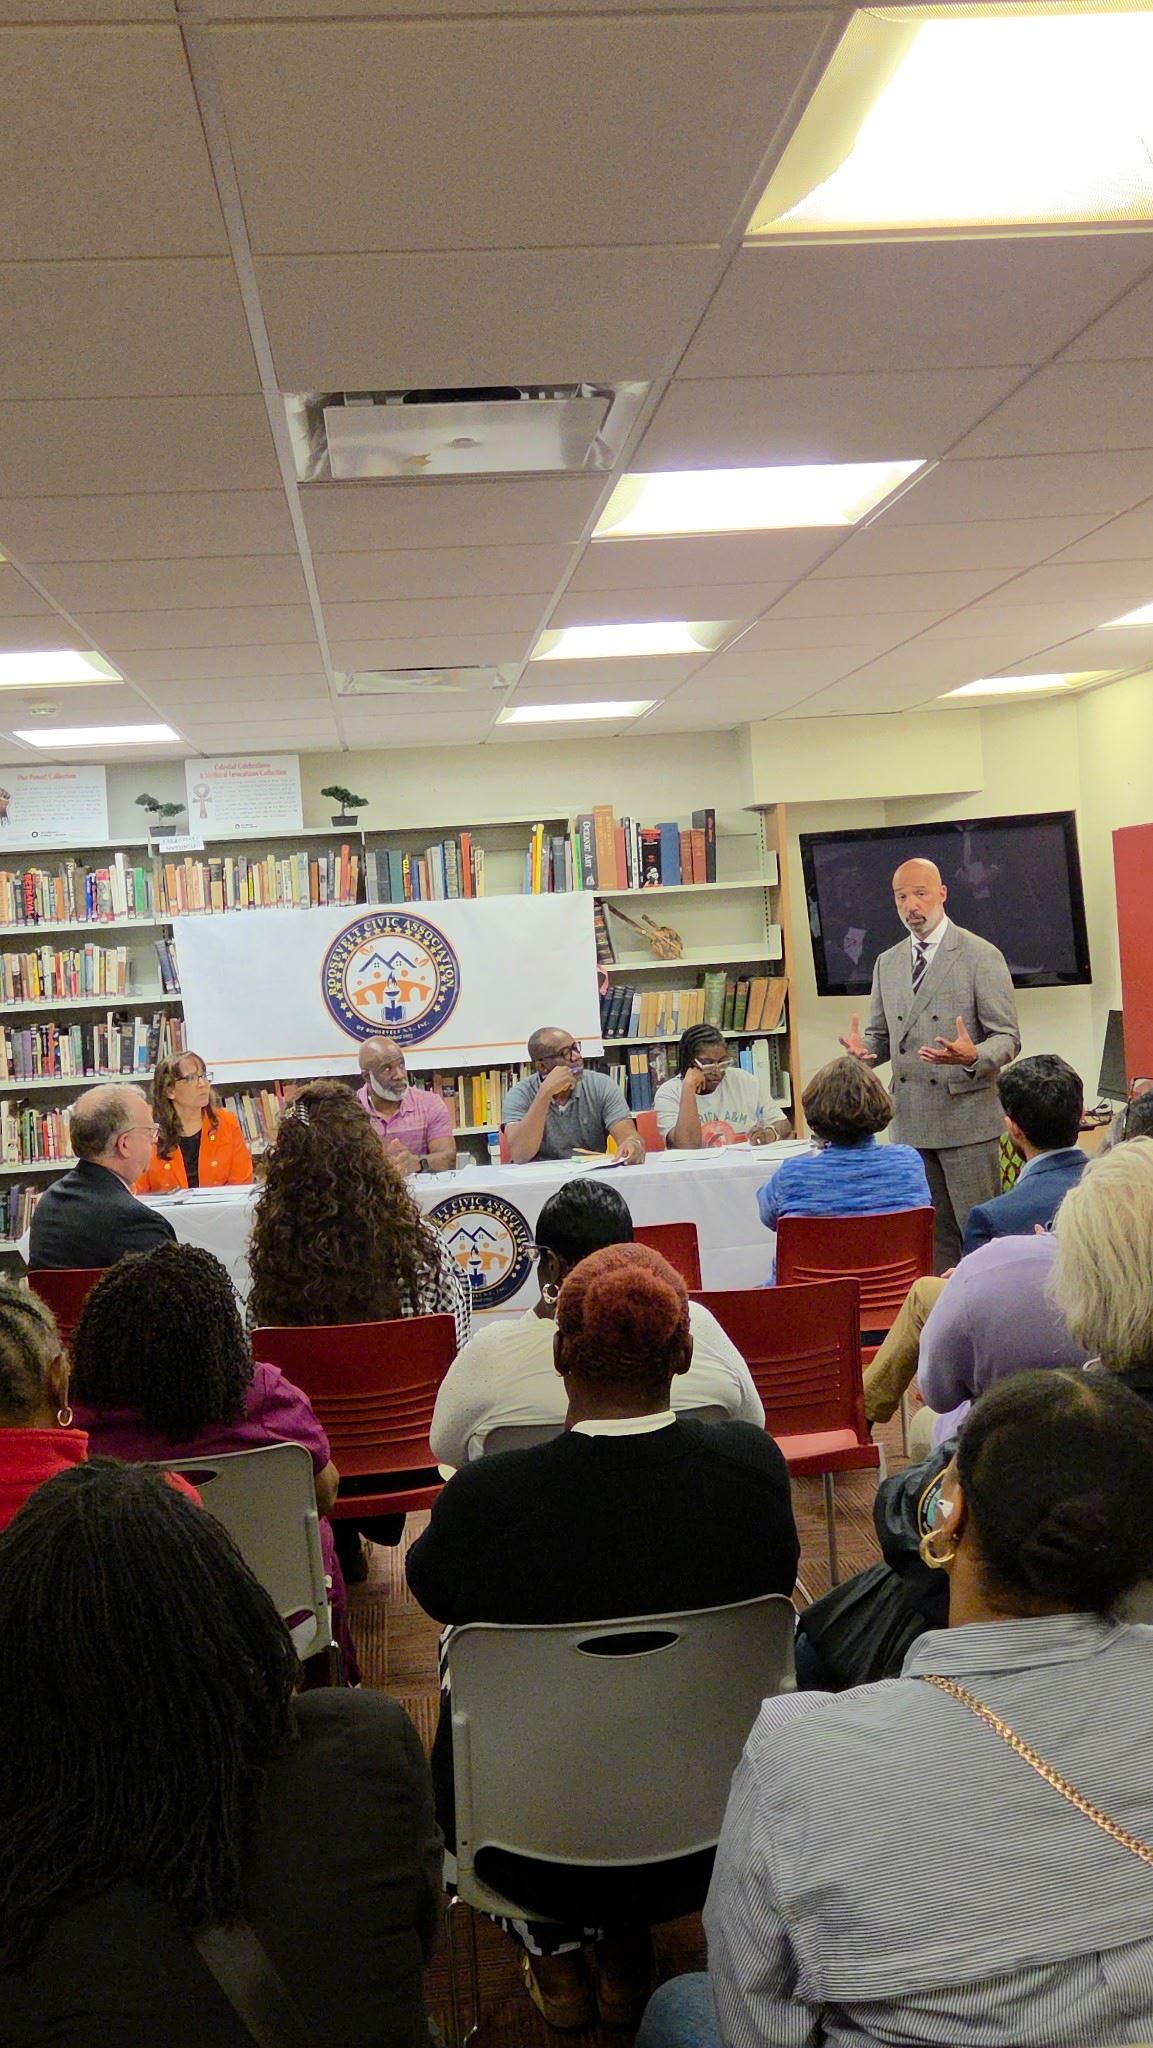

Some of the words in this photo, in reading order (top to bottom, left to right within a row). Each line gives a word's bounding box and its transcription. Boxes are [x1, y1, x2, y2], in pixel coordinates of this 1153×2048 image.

[582, 821, 592, 852] OCEANIC
[584, 854, 593, 868] ART
[327, 929, 362, 996] ROOSEVELT
[363, 917, 400, 931] CIVIC
[402, 919, 455, 988] ASSOCIATION
[451, 1197, 481, 1209] CIVIC
[486, 1199, 529, 1249] ASSOCIATI
